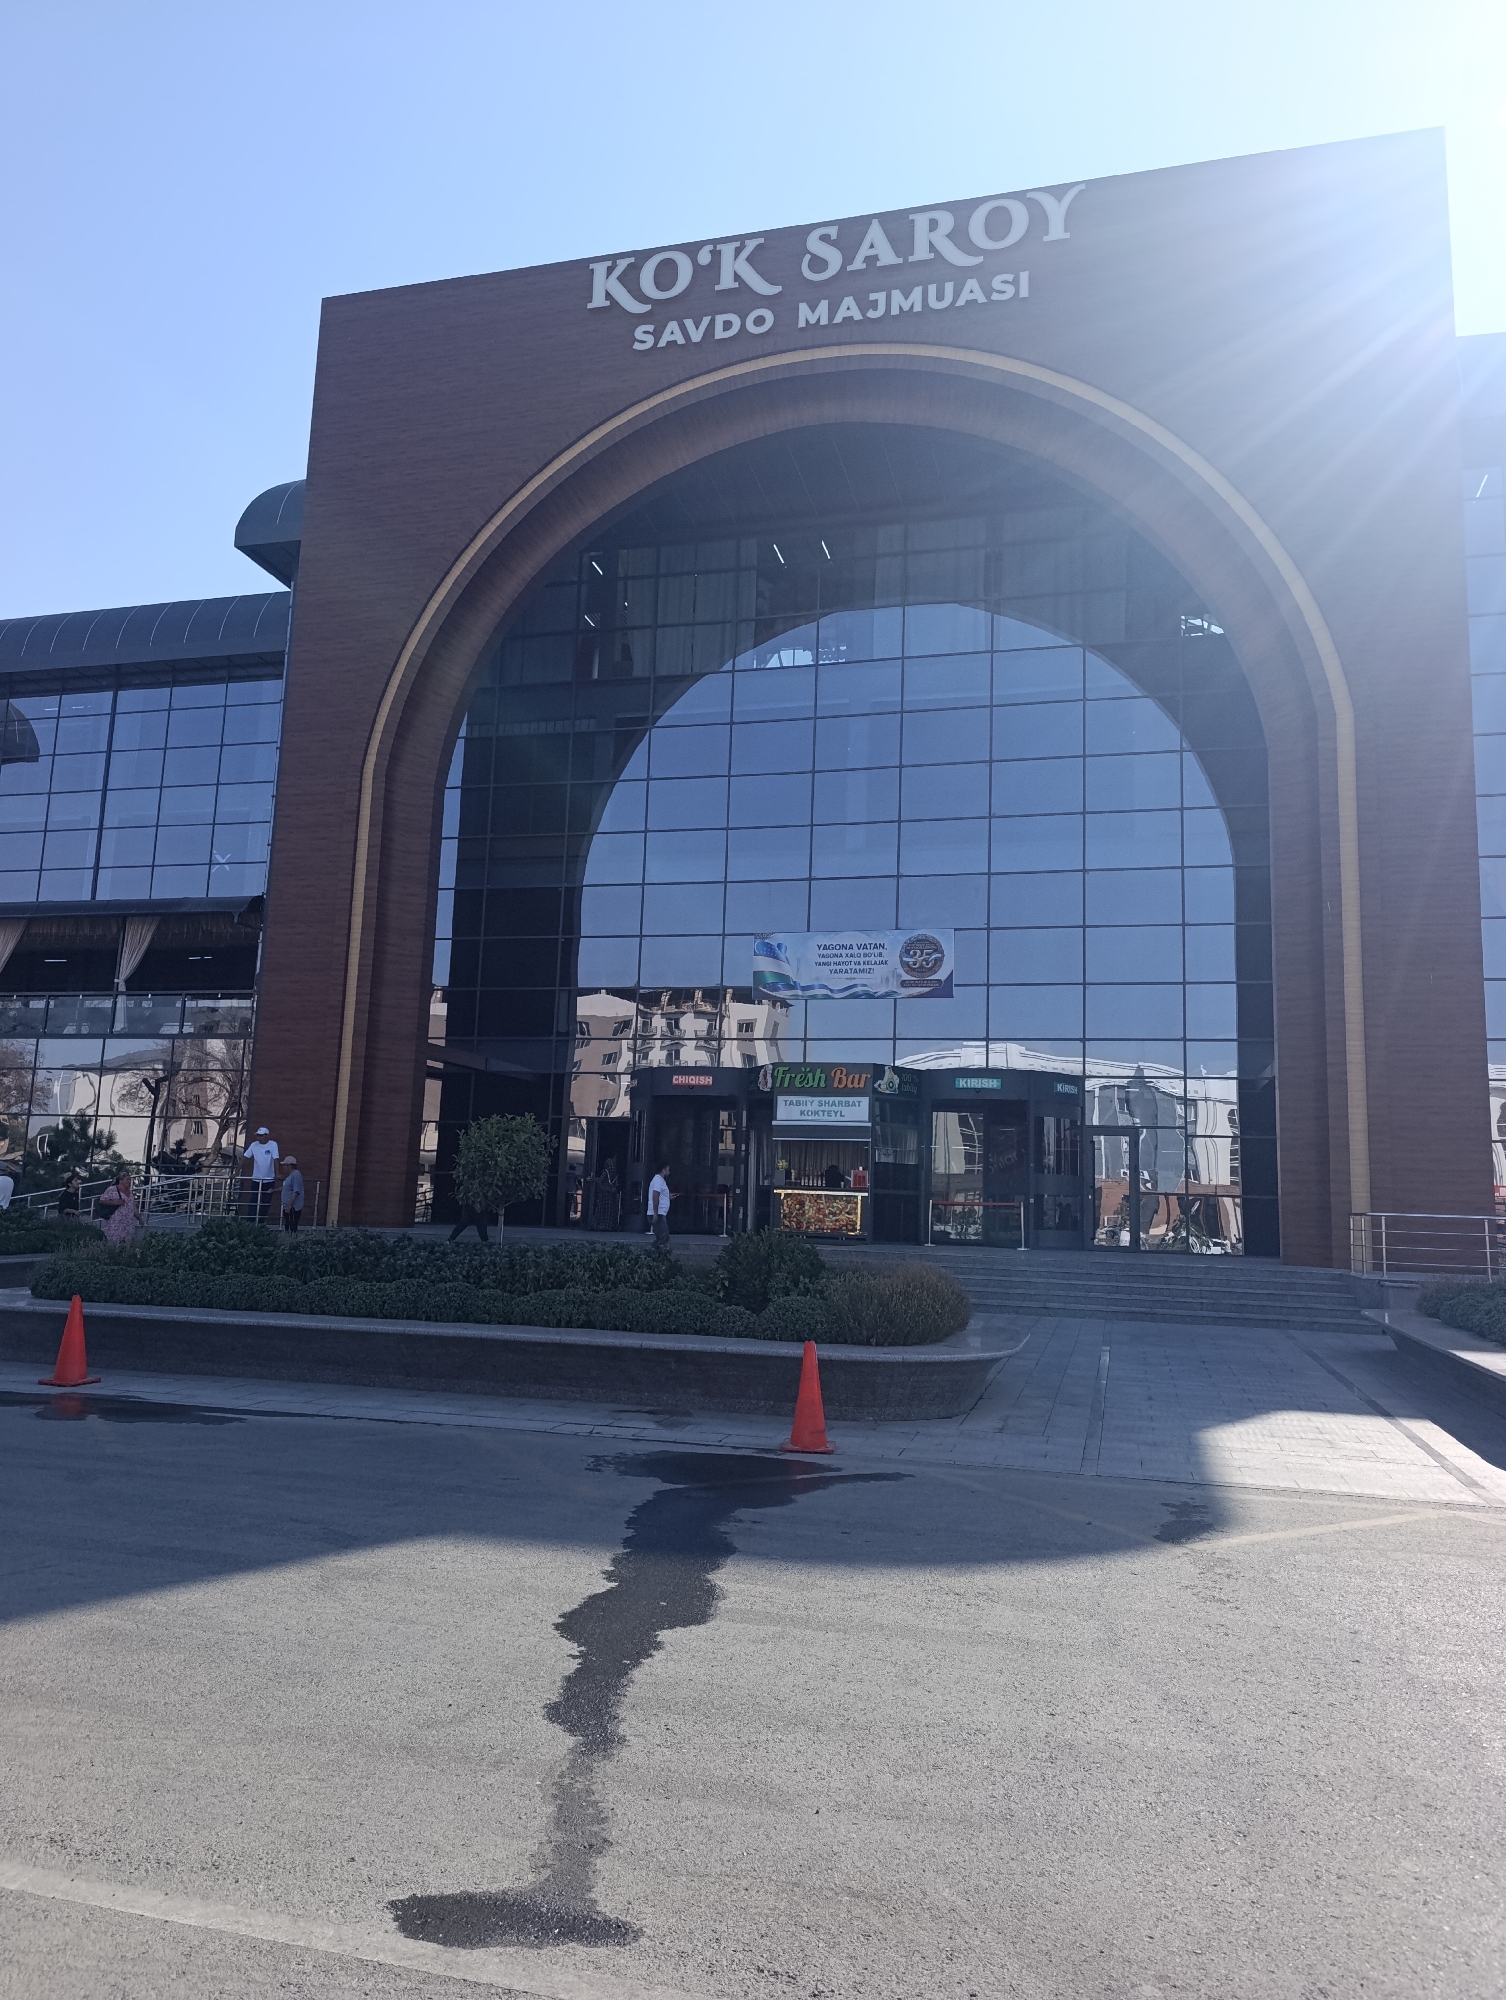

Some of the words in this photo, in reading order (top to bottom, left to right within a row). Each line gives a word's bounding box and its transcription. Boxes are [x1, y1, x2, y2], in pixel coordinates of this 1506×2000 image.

[801, 184, 1086, 281] SAROY
[633, 308, 774, 350] SAVDO
[798, 271, 1029, 328] MAJMUASI
[909, 949, 935, 968] 35
[672, 1075, 713, 1085] CHIQISH
[831, 1067, 871, 1089] Bar
[959, 1078, 998, 1088] KIRISH
[1057, 1082, 1078, 1095] KIRISH
[783, 1099, 816, 1107] TABIIY
[817, 1100, 863, 1108] SHARBAT
[799, 1109, 846, 1118] KOKTEYL
